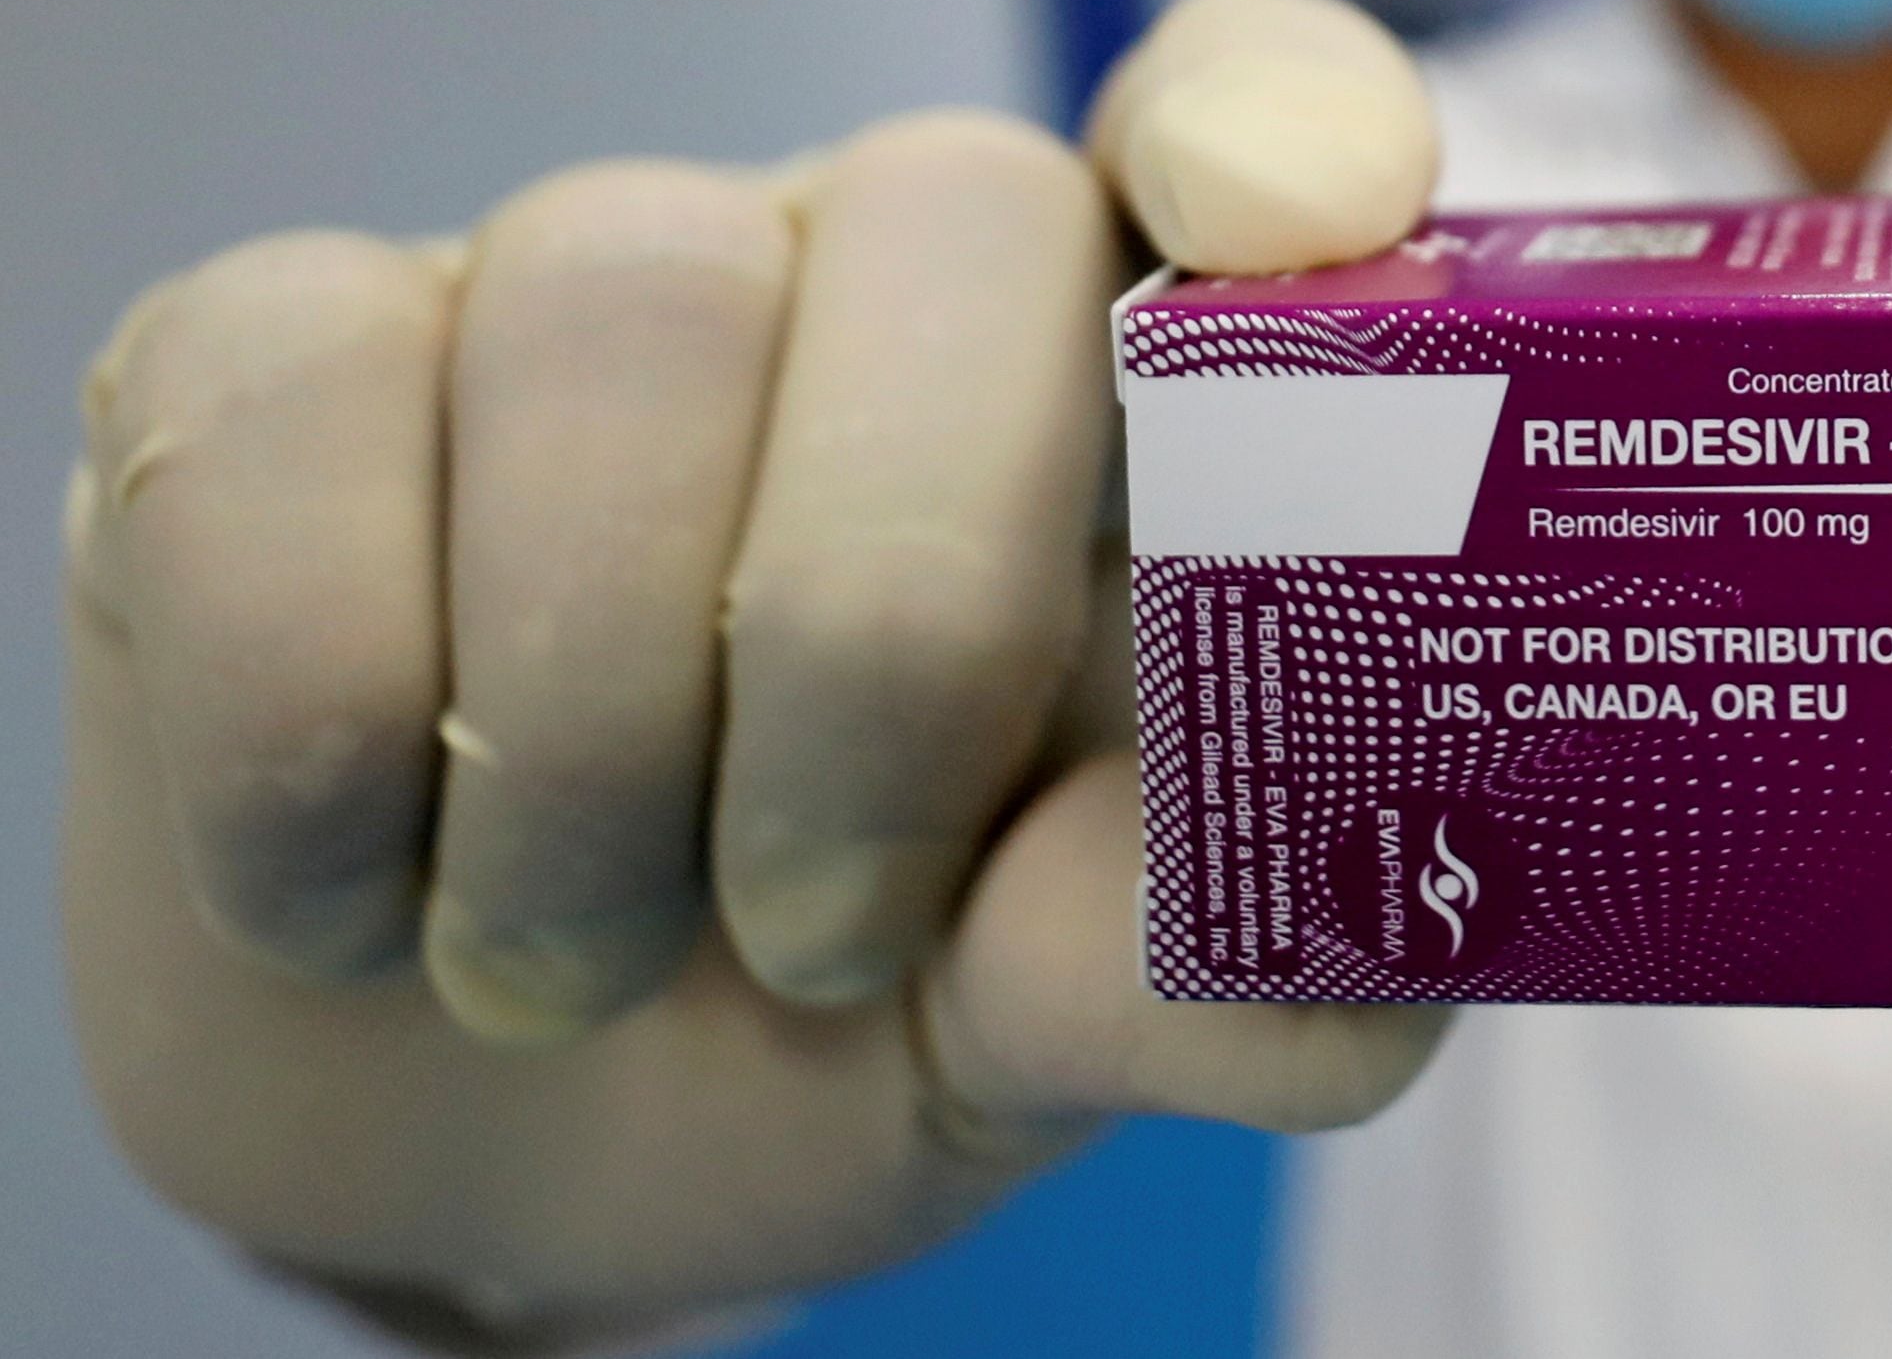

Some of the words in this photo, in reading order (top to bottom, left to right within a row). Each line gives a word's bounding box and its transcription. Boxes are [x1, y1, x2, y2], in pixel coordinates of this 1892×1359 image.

[1524, 417, 1871, 466] REMDESIVIR
[1529, 507, 1720, 538] Remdesivir
[1743, 508, 1805, 538] 100
[1817, 514, 1870, 545] mg
[1225, 586, 1246, 605] is
[1194, 586, 1216, 667] license
[1420, 627, 1510, 664] NOT
[1523, 627, 1611, 664] FOR
[1198, 673, 1220, 724] from
[1227, 611, 1254, 768] manufactured
[1257, 605, 1285, 763] REMDESIVIR
[1422, 683, 1492, 728] US,
[1505, 683, 1699, 727] CANADA,
[1711, 683, 1775, 721] OR
[1789, 684, 1847, 721] EU
[1201, 730, 1225, 805] Gilead
[1233, 774, 1256, 840] under
[1264, 786, 1288, 836] EVA
[1204, 811, 1227, 920] Sciences,
[1237, 845, 1254, 860] a
[1237, 866, 1261, 969] voluntary
[1268, 844, 1293, 950] PHARMA
[1210, 927, 1231, 966] Inc.
